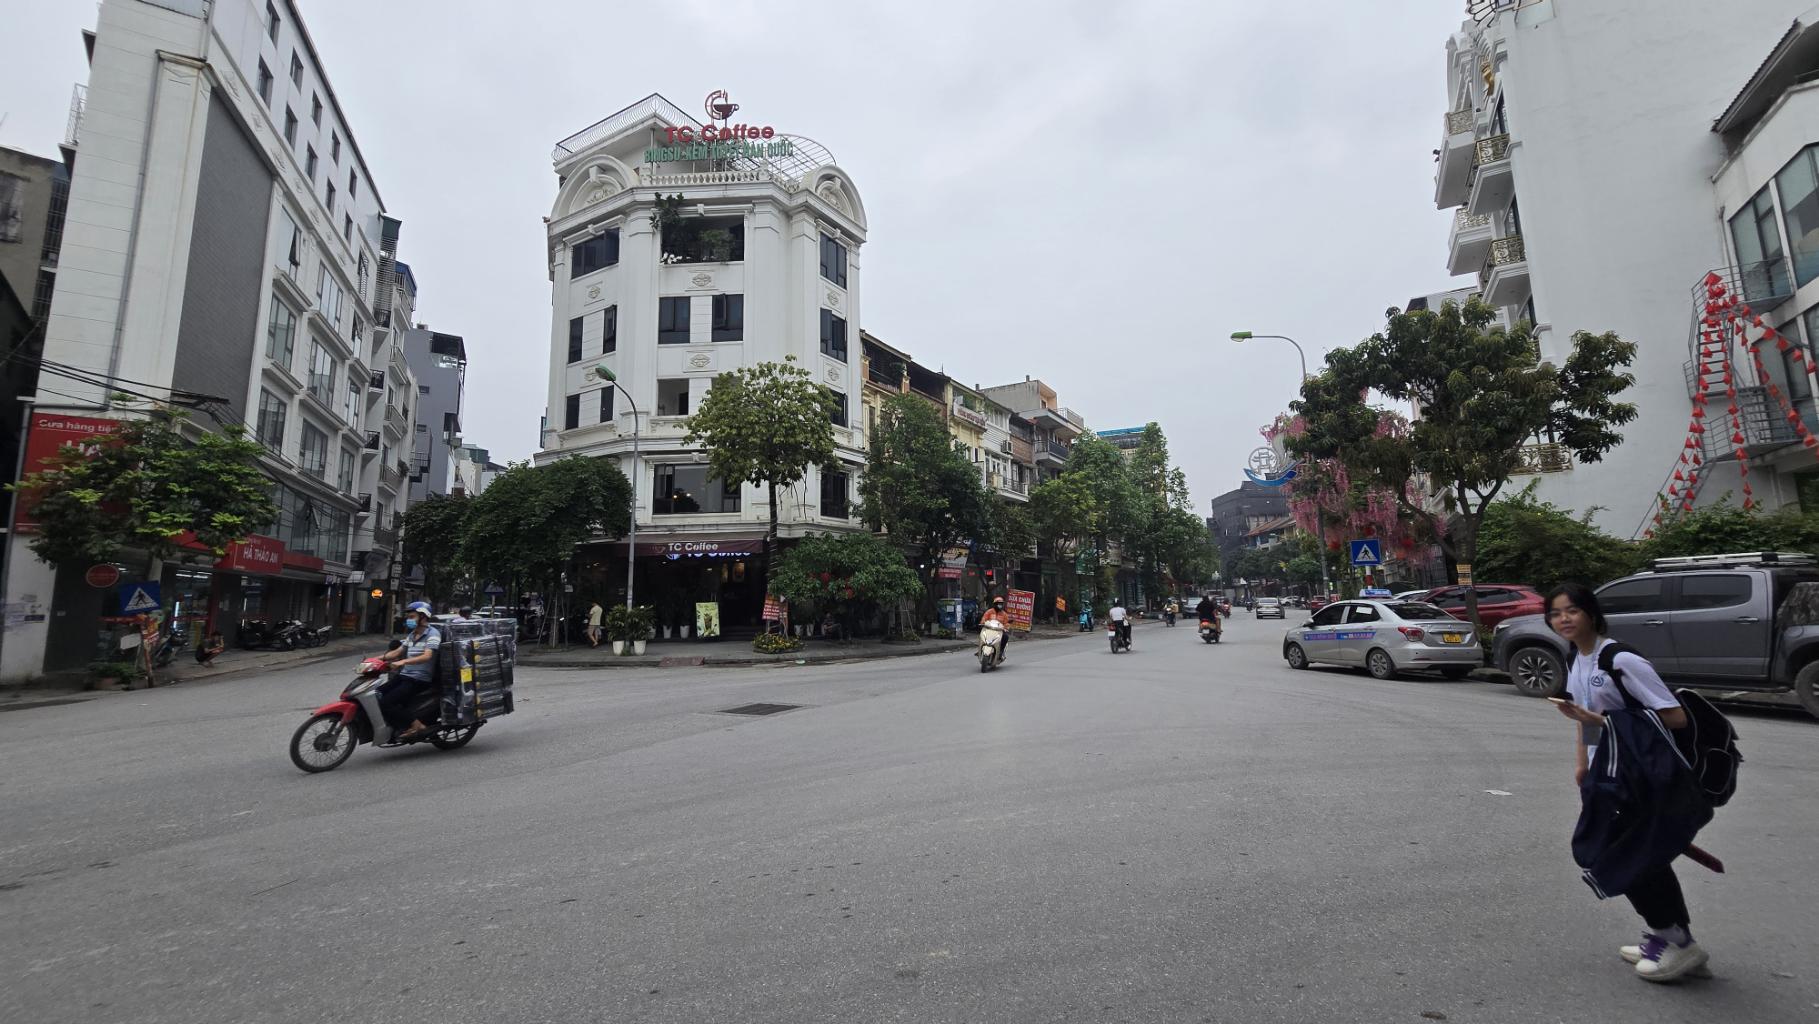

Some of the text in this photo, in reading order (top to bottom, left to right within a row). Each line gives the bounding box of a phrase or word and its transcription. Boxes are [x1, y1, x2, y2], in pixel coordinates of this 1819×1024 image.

[664, 124, 775, 144] TC Coffee
[667, 542, 719, 551] TC Coffee
